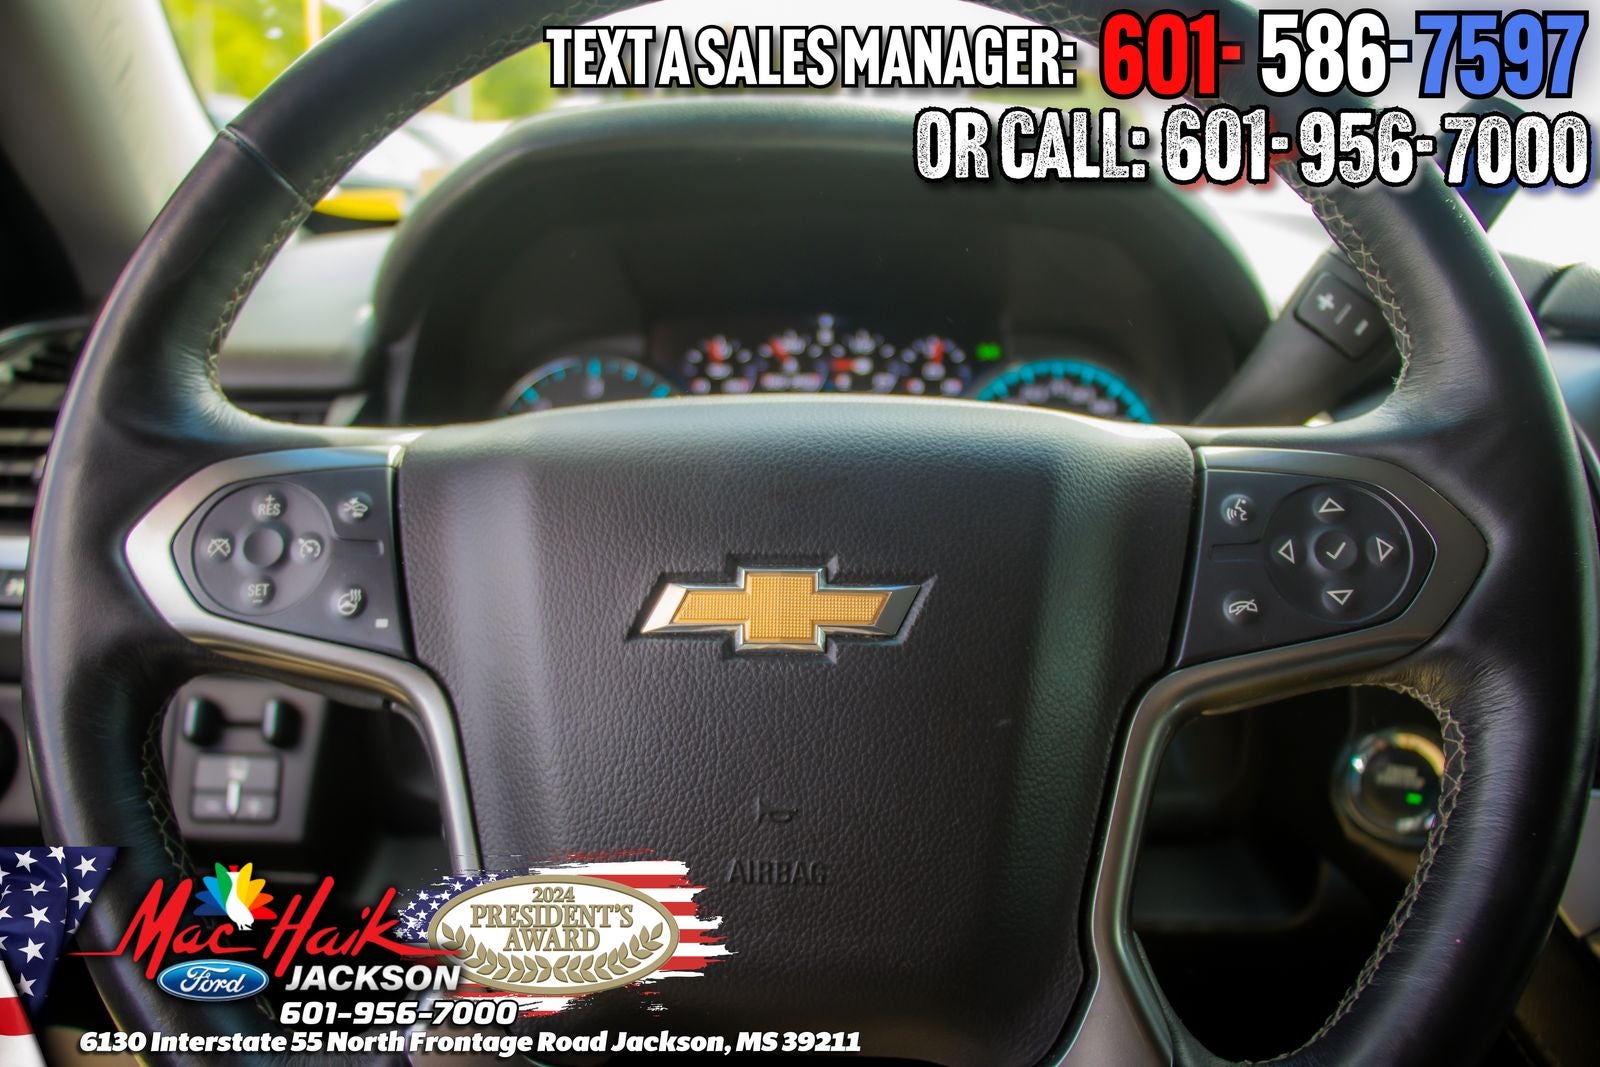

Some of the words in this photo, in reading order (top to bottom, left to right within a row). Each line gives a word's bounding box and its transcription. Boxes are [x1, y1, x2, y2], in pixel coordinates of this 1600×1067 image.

[257, 503, 281, 516] RES
[247, 583, 270, 597] SET
[724, 859, 826, 884] AIRBAG
